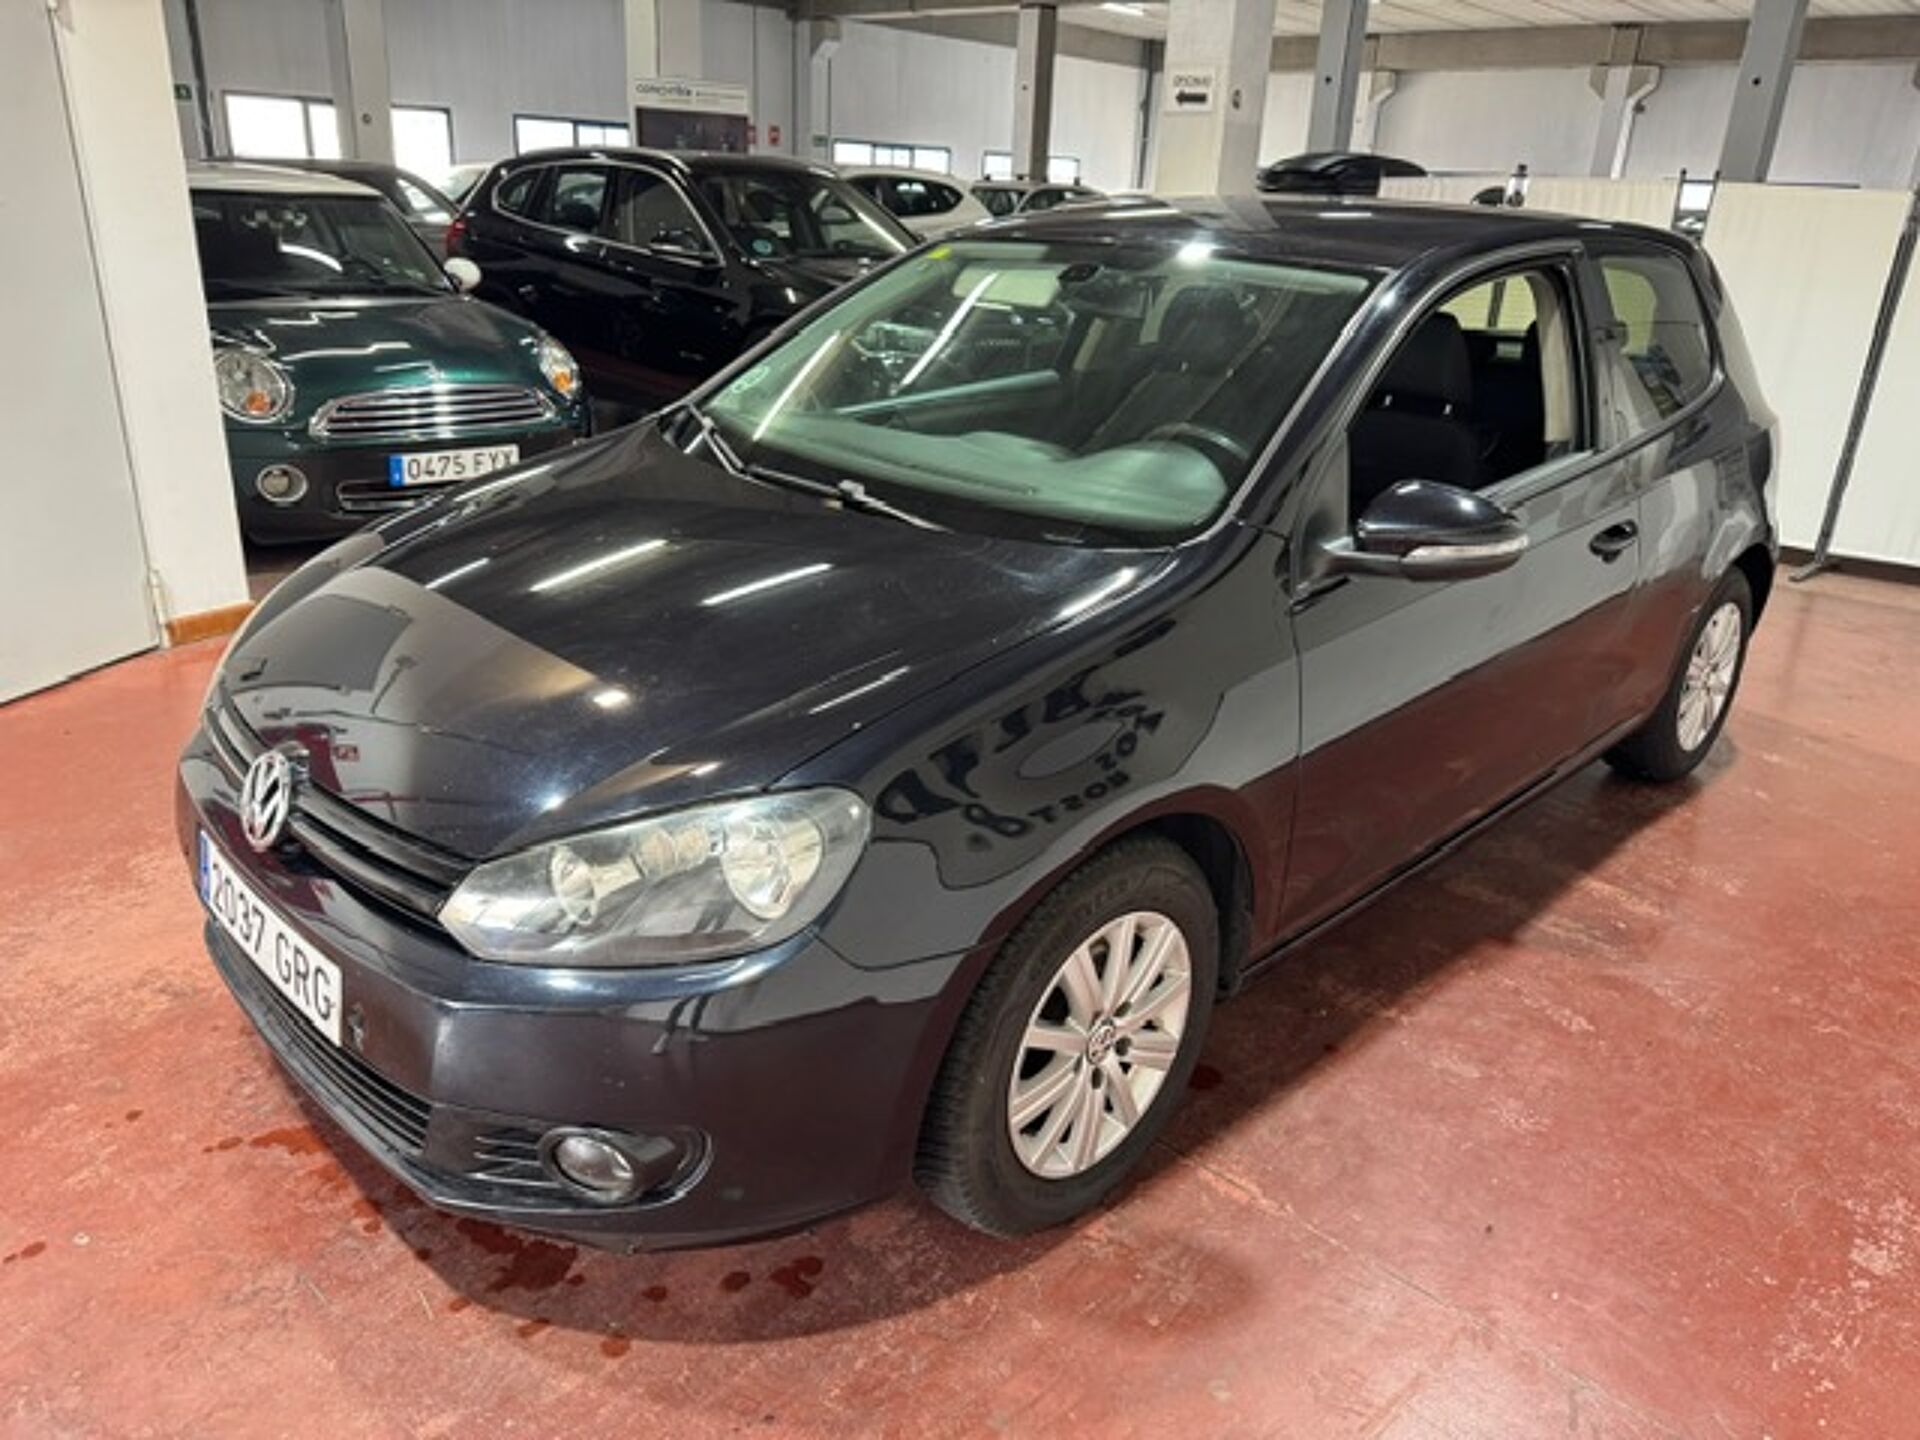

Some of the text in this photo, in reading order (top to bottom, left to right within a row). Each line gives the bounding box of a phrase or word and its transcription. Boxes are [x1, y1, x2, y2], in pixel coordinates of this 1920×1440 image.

[407, 454, 466, 480] 0475
[212, 862, 335, 1021] 2037 GRG
